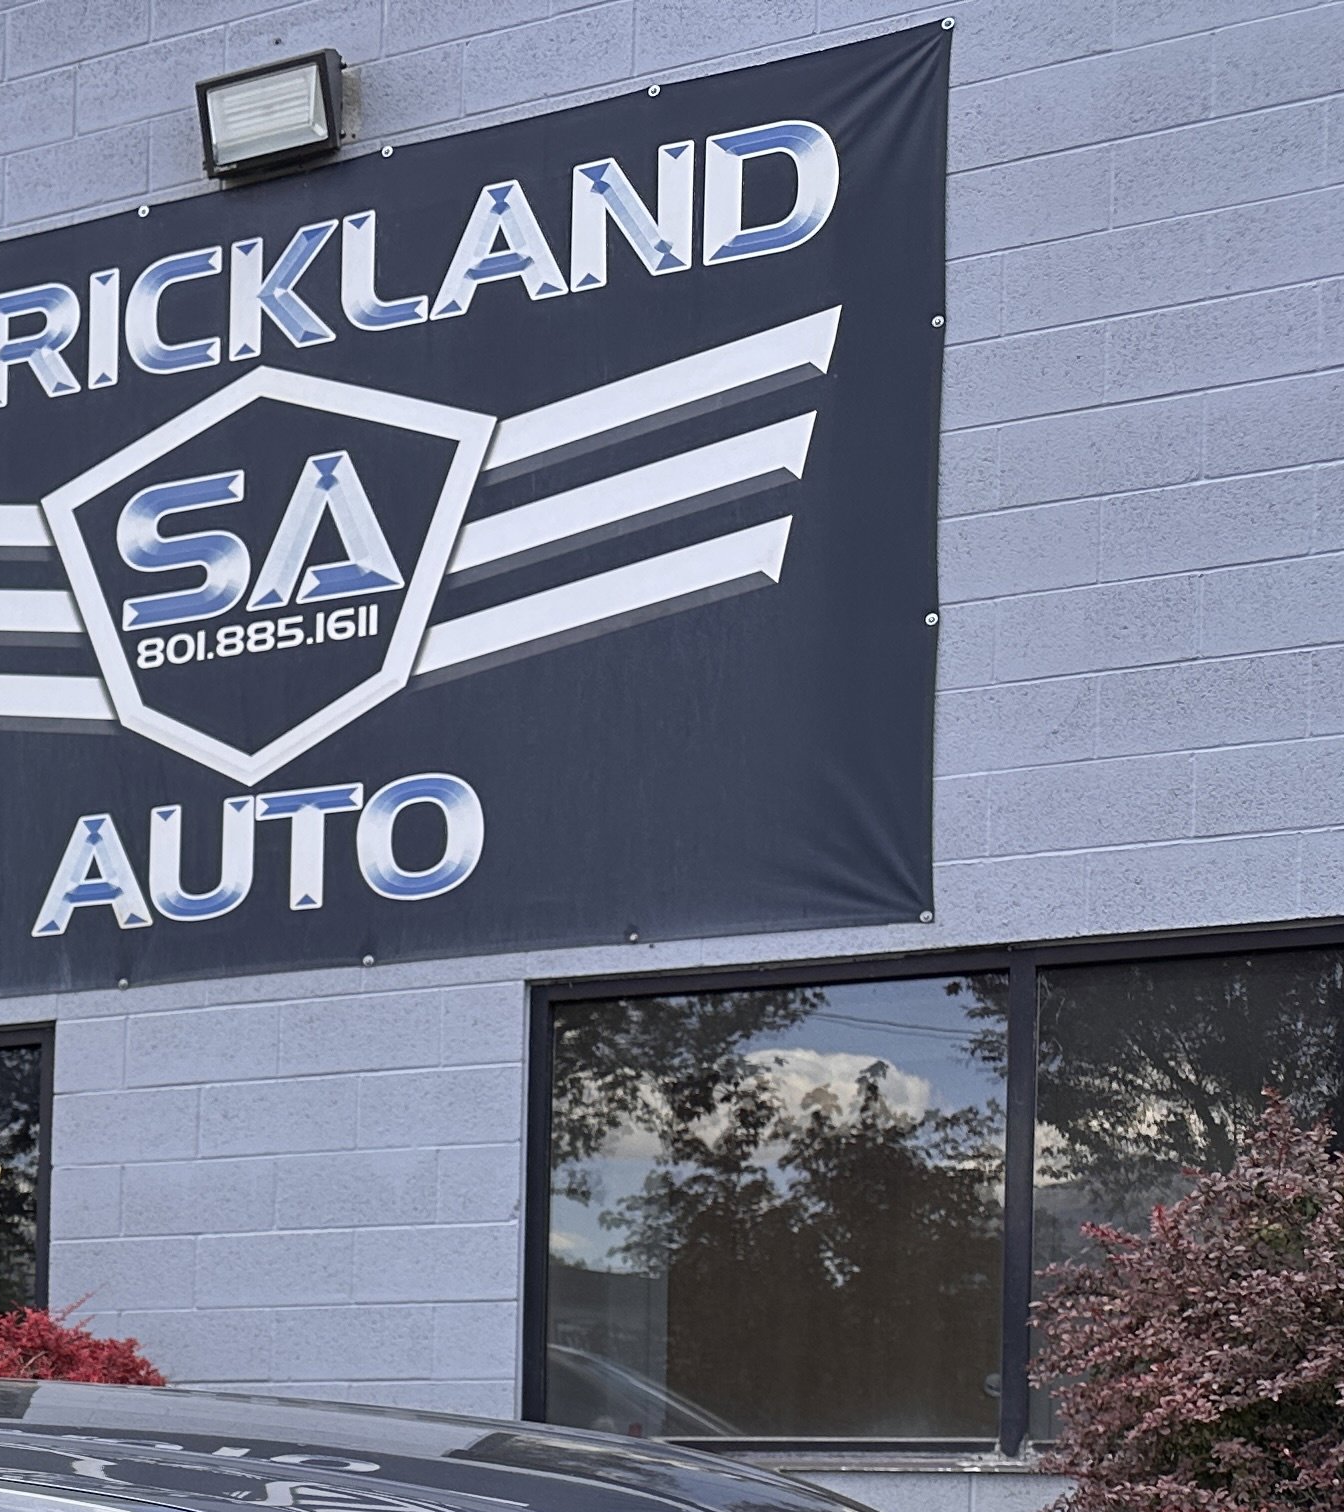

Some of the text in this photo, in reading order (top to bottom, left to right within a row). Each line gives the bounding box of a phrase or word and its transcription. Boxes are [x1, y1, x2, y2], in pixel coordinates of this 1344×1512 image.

[115, 449, 405, 631] SA
[136, 604, 381, 671] 801.885.1611
[30, 772, 485, 937] AUTO
